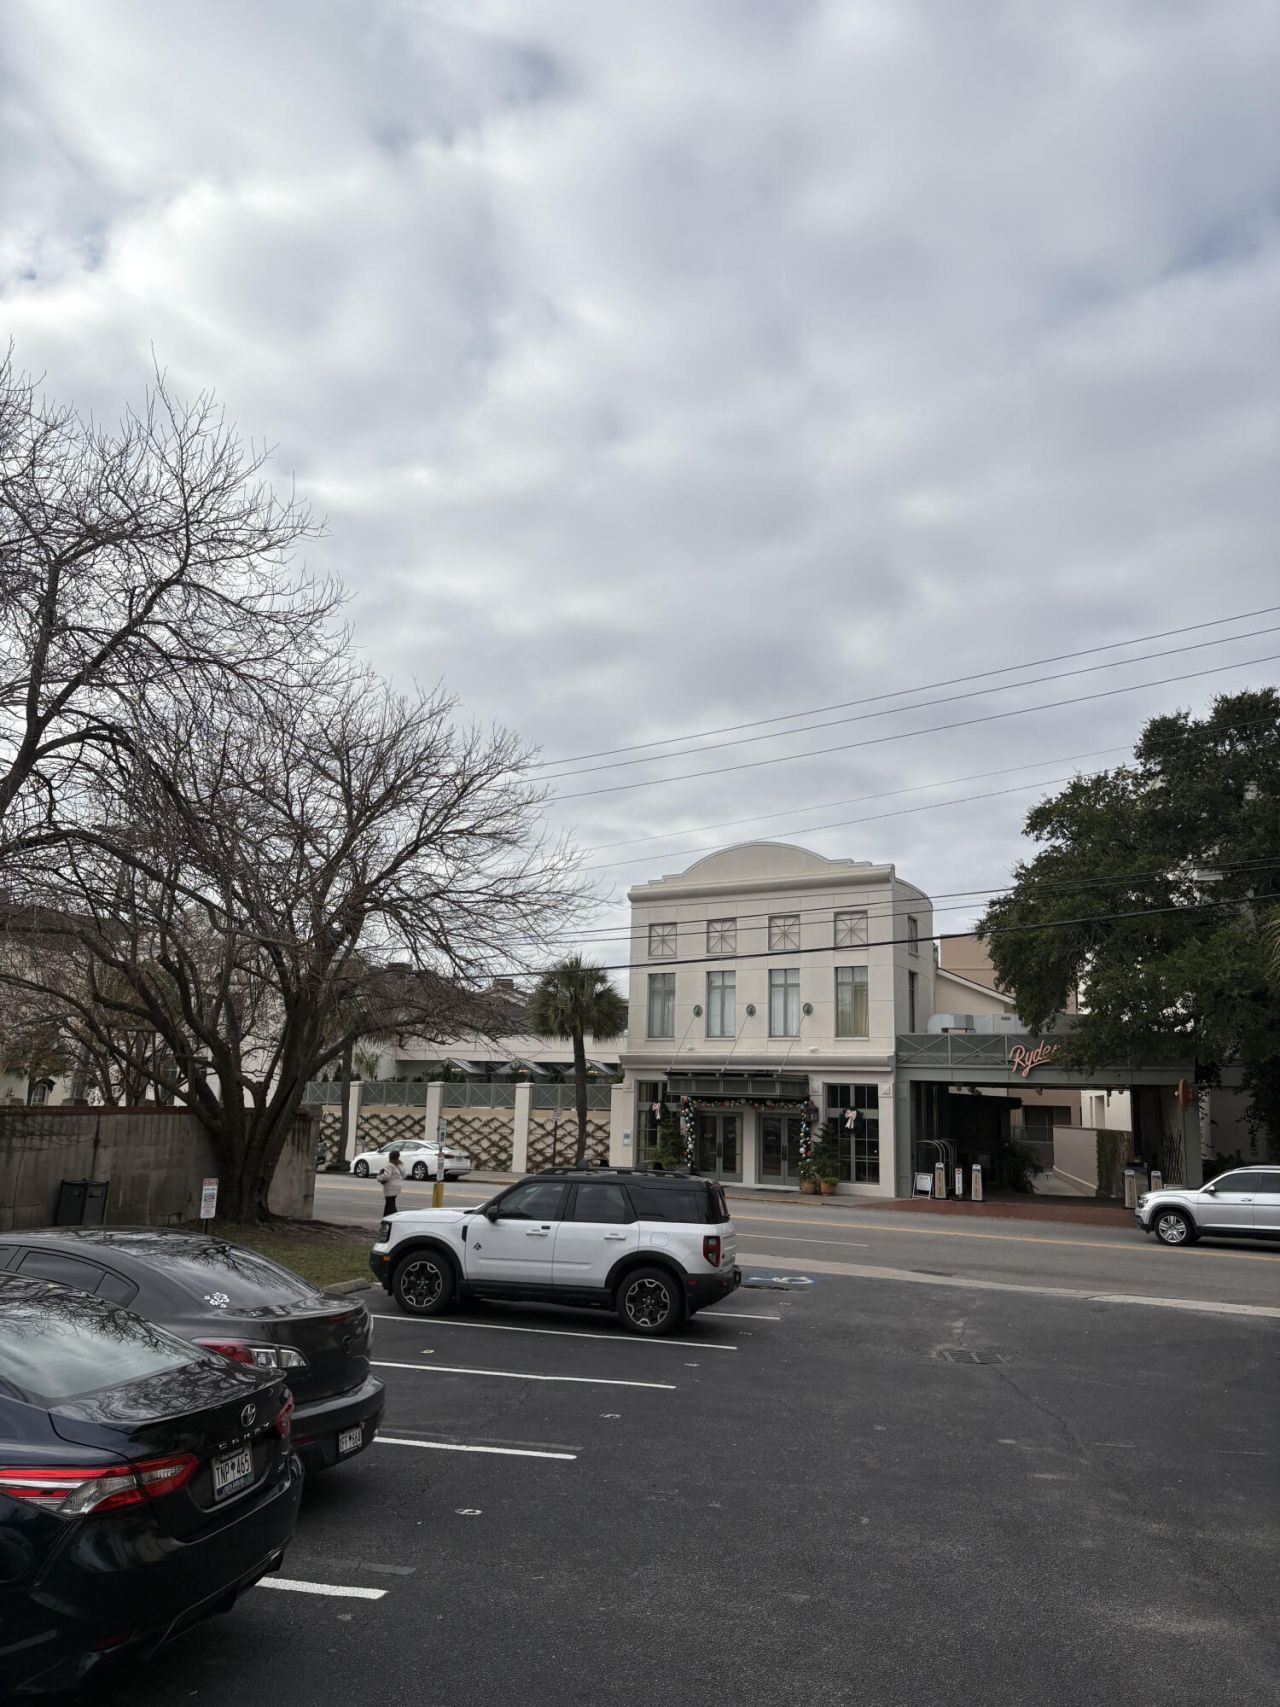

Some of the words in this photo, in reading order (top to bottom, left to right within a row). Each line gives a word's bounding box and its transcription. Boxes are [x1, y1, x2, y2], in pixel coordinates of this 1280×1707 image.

[1009, 1040, 1061, 1077] Ryder
[218, 1422, 270, 1449] CAMRY
[215, 1462, 230, 1486] TNP
[236, 1453, 250, 1476] 465
